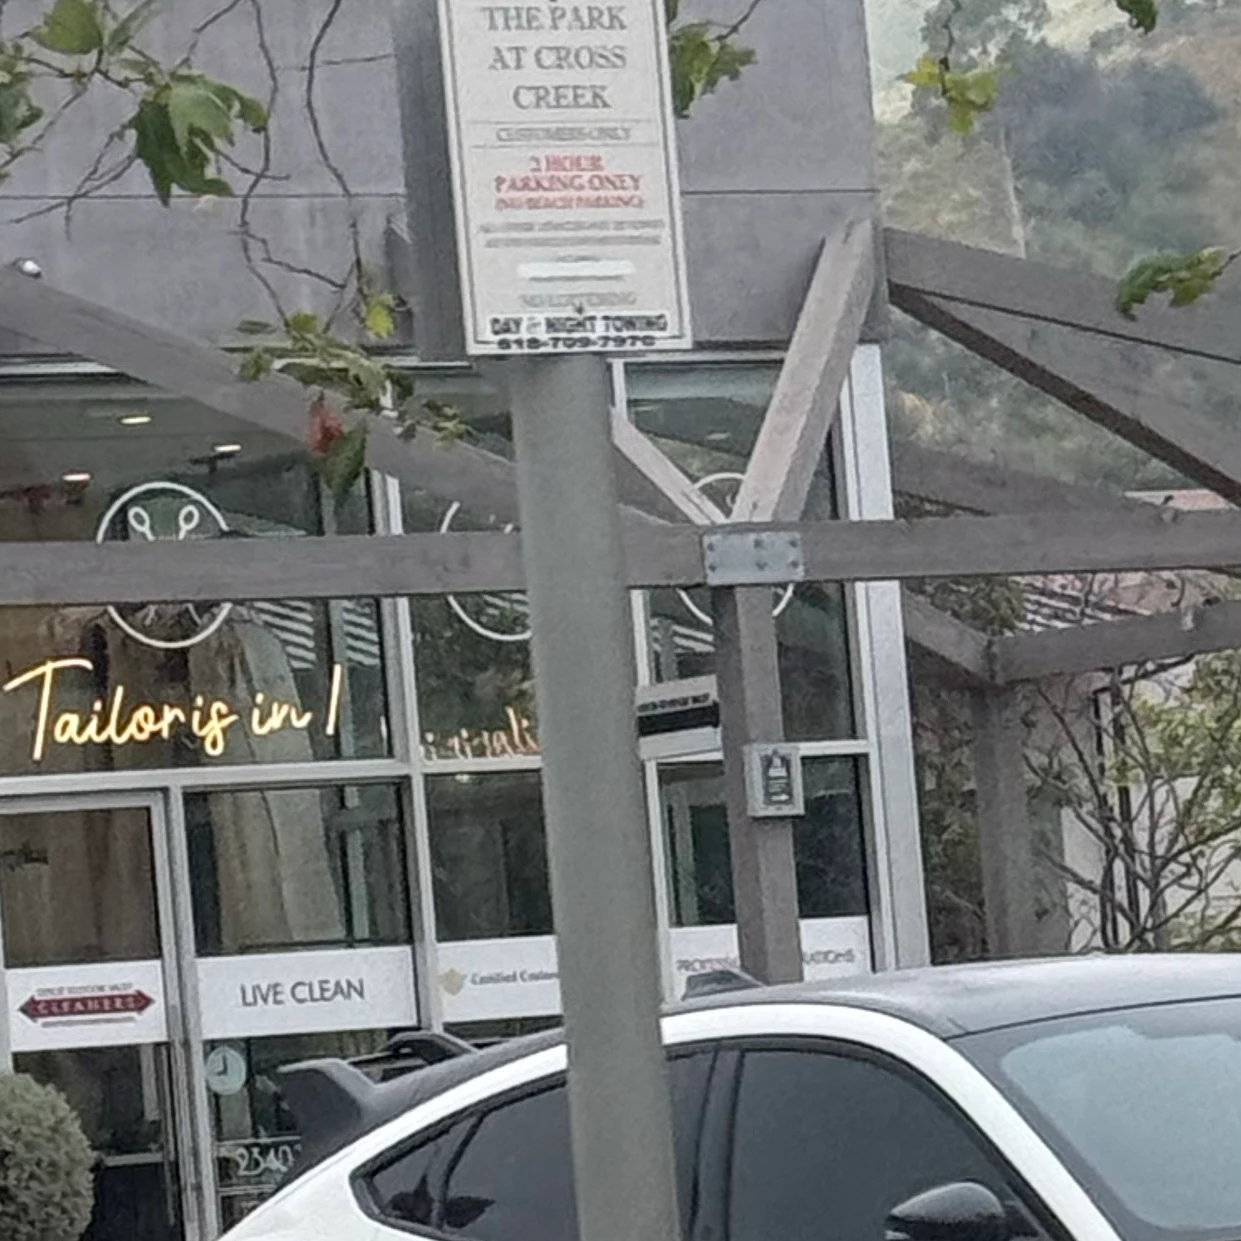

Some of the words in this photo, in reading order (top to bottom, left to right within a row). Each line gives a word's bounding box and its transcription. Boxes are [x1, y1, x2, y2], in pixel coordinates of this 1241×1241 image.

[480, 6, 544, 31] THE
[549, 5, 627, 31] PARK
[488, 45, 527, 71] AT
[534, 45, 627, 70] CROSS
[512, 84, 612, 110] CREEK
[495, 175, 585, 194] PARKING
[587, 174, 643, 191] ONLY
[601, 313, 668, 333] TOWING
[240, 982, 286, 1007] LIVE
[290, 978, 365, 1004] CLEAN
